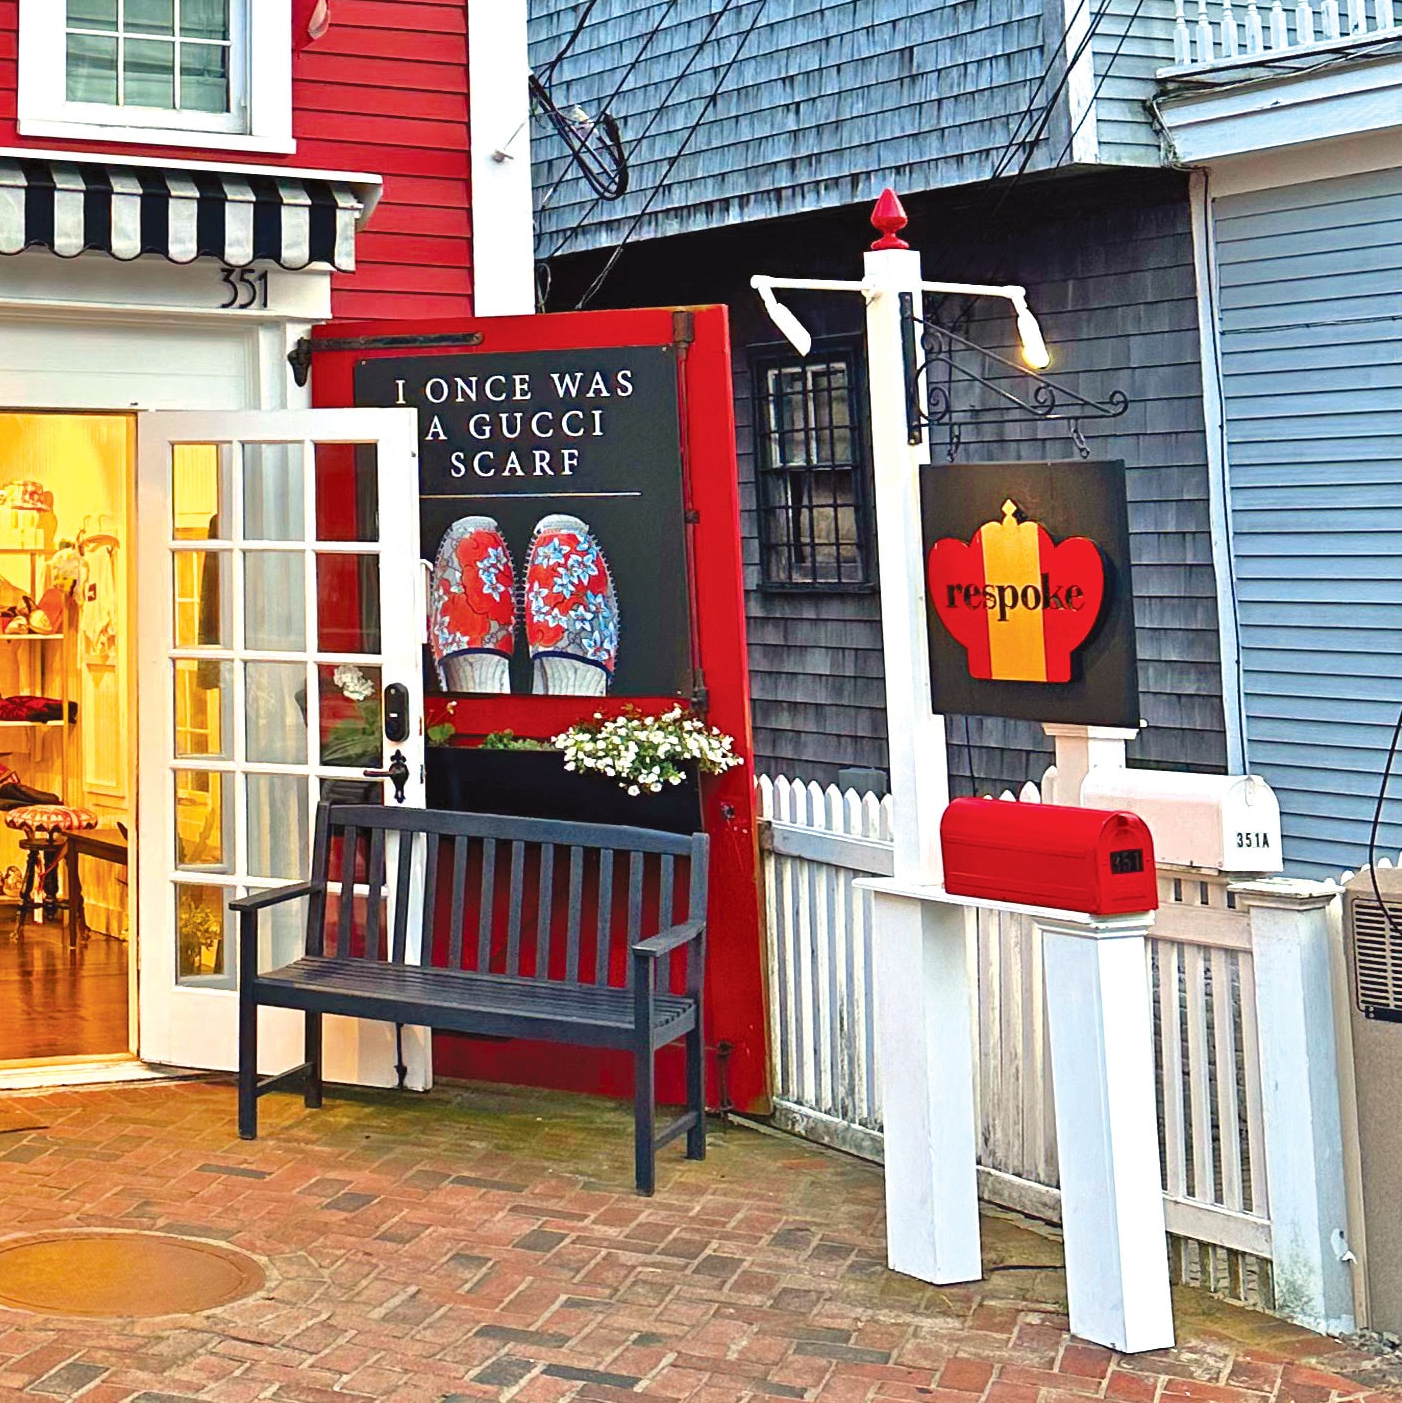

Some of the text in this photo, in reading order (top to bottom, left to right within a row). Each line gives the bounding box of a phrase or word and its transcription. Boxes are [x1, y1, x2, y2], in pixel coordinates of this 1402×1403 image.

[219, 265, 269, 309] 351
[395, 370, 634, 404] I ONCE WAS
[424, 410, 604, 441] A GUCCI
[450, 449, 580, 478] SCARF
[945, 572, 1085, 623] respoke
[1236, 831, 1271, 849] 351A
